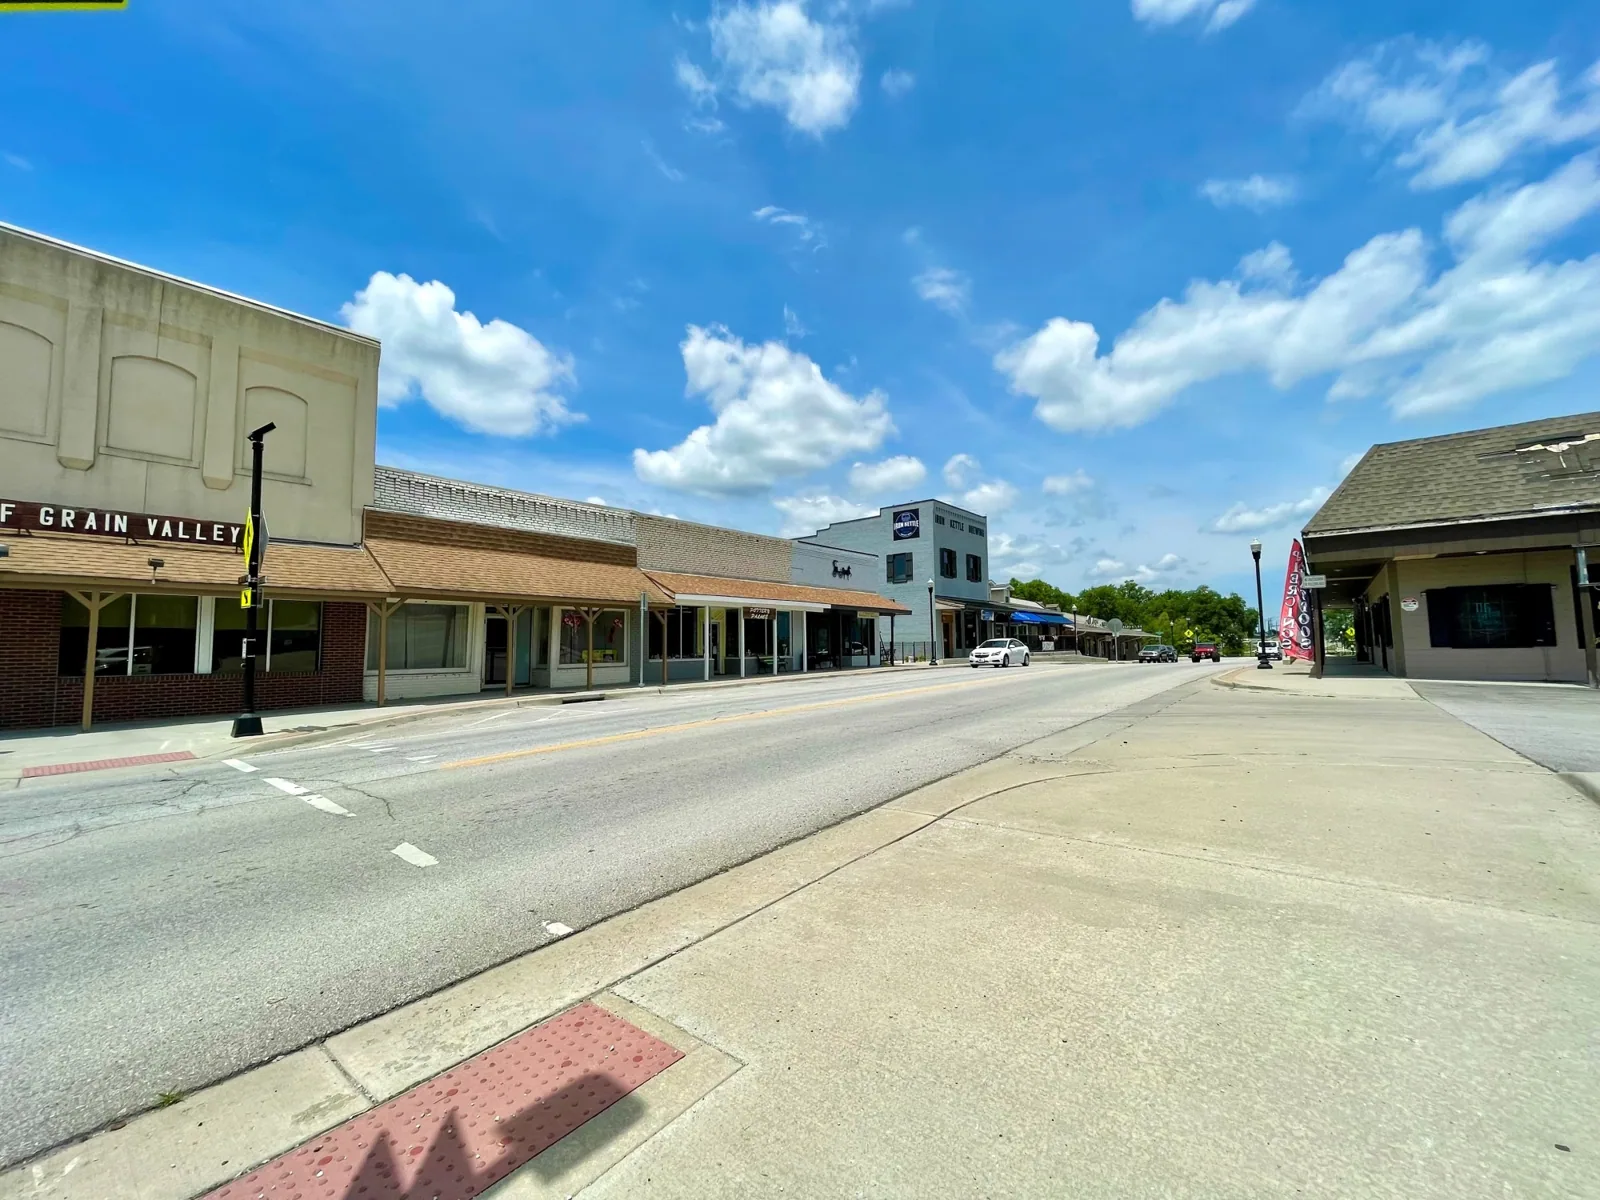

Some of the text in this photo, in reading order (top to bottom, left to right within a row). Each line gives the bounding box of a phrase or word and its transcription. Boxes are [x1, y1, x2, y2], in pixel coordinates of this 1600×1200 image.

[39, 506, 128, 533] GRAIN
[147, 518, 241, 543] VALLEY
[949, 519, 964, 532] KETTLE
